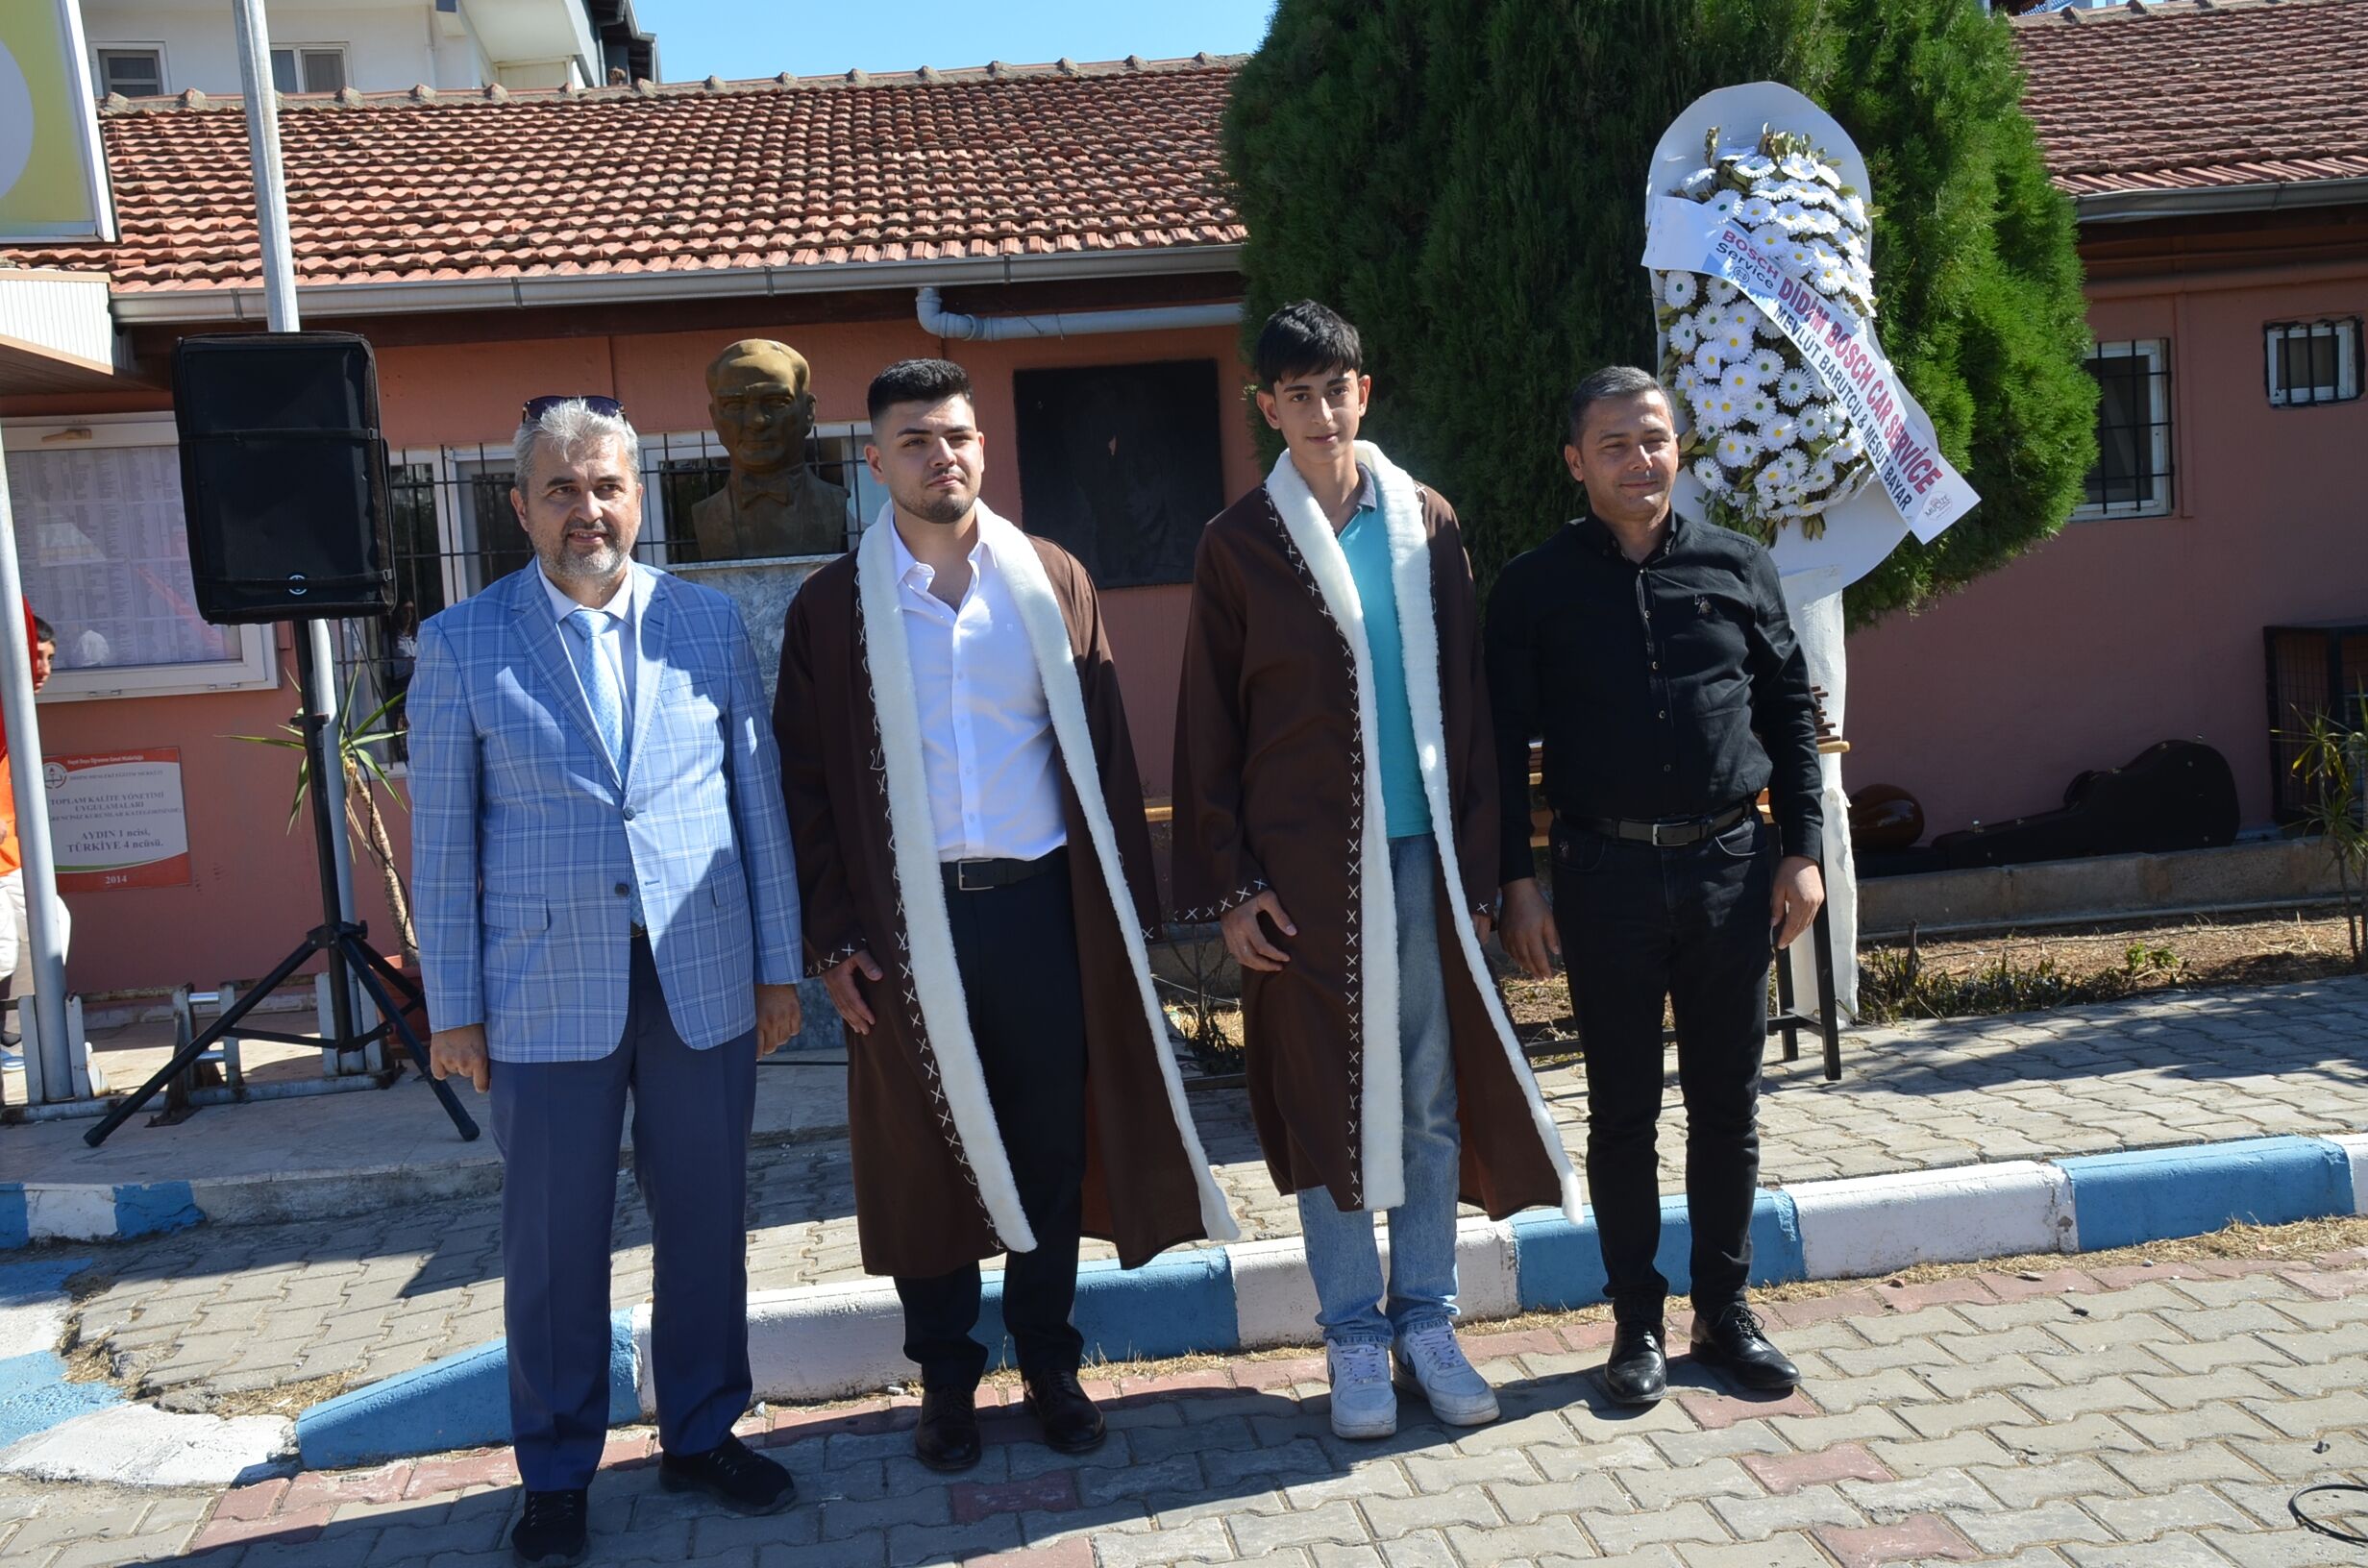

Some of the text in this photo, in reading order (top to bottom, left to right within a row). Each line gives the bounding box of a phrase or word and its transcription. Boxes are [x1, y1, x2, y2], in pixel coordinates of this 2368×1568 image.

[1715, 242, 1774, 289] Service
[1722, 230, 1779, 279] BOSCH
[1824, 321, 1876, 392] BOSCH
[1866, 380, 1893, 428] CAR
[1773, 305, 1822, 359] MEVLÜT
[1857, 413, 1868, 429] &
[1863, 424, 1889, 470] MESUT
[1884, 465, 1912, 512] BAYAR
[67, 840, 121, 853] TÜRKİYE
[82, 829, 115, 841] AYDIN
[106, 875, 128, 885] 2014
